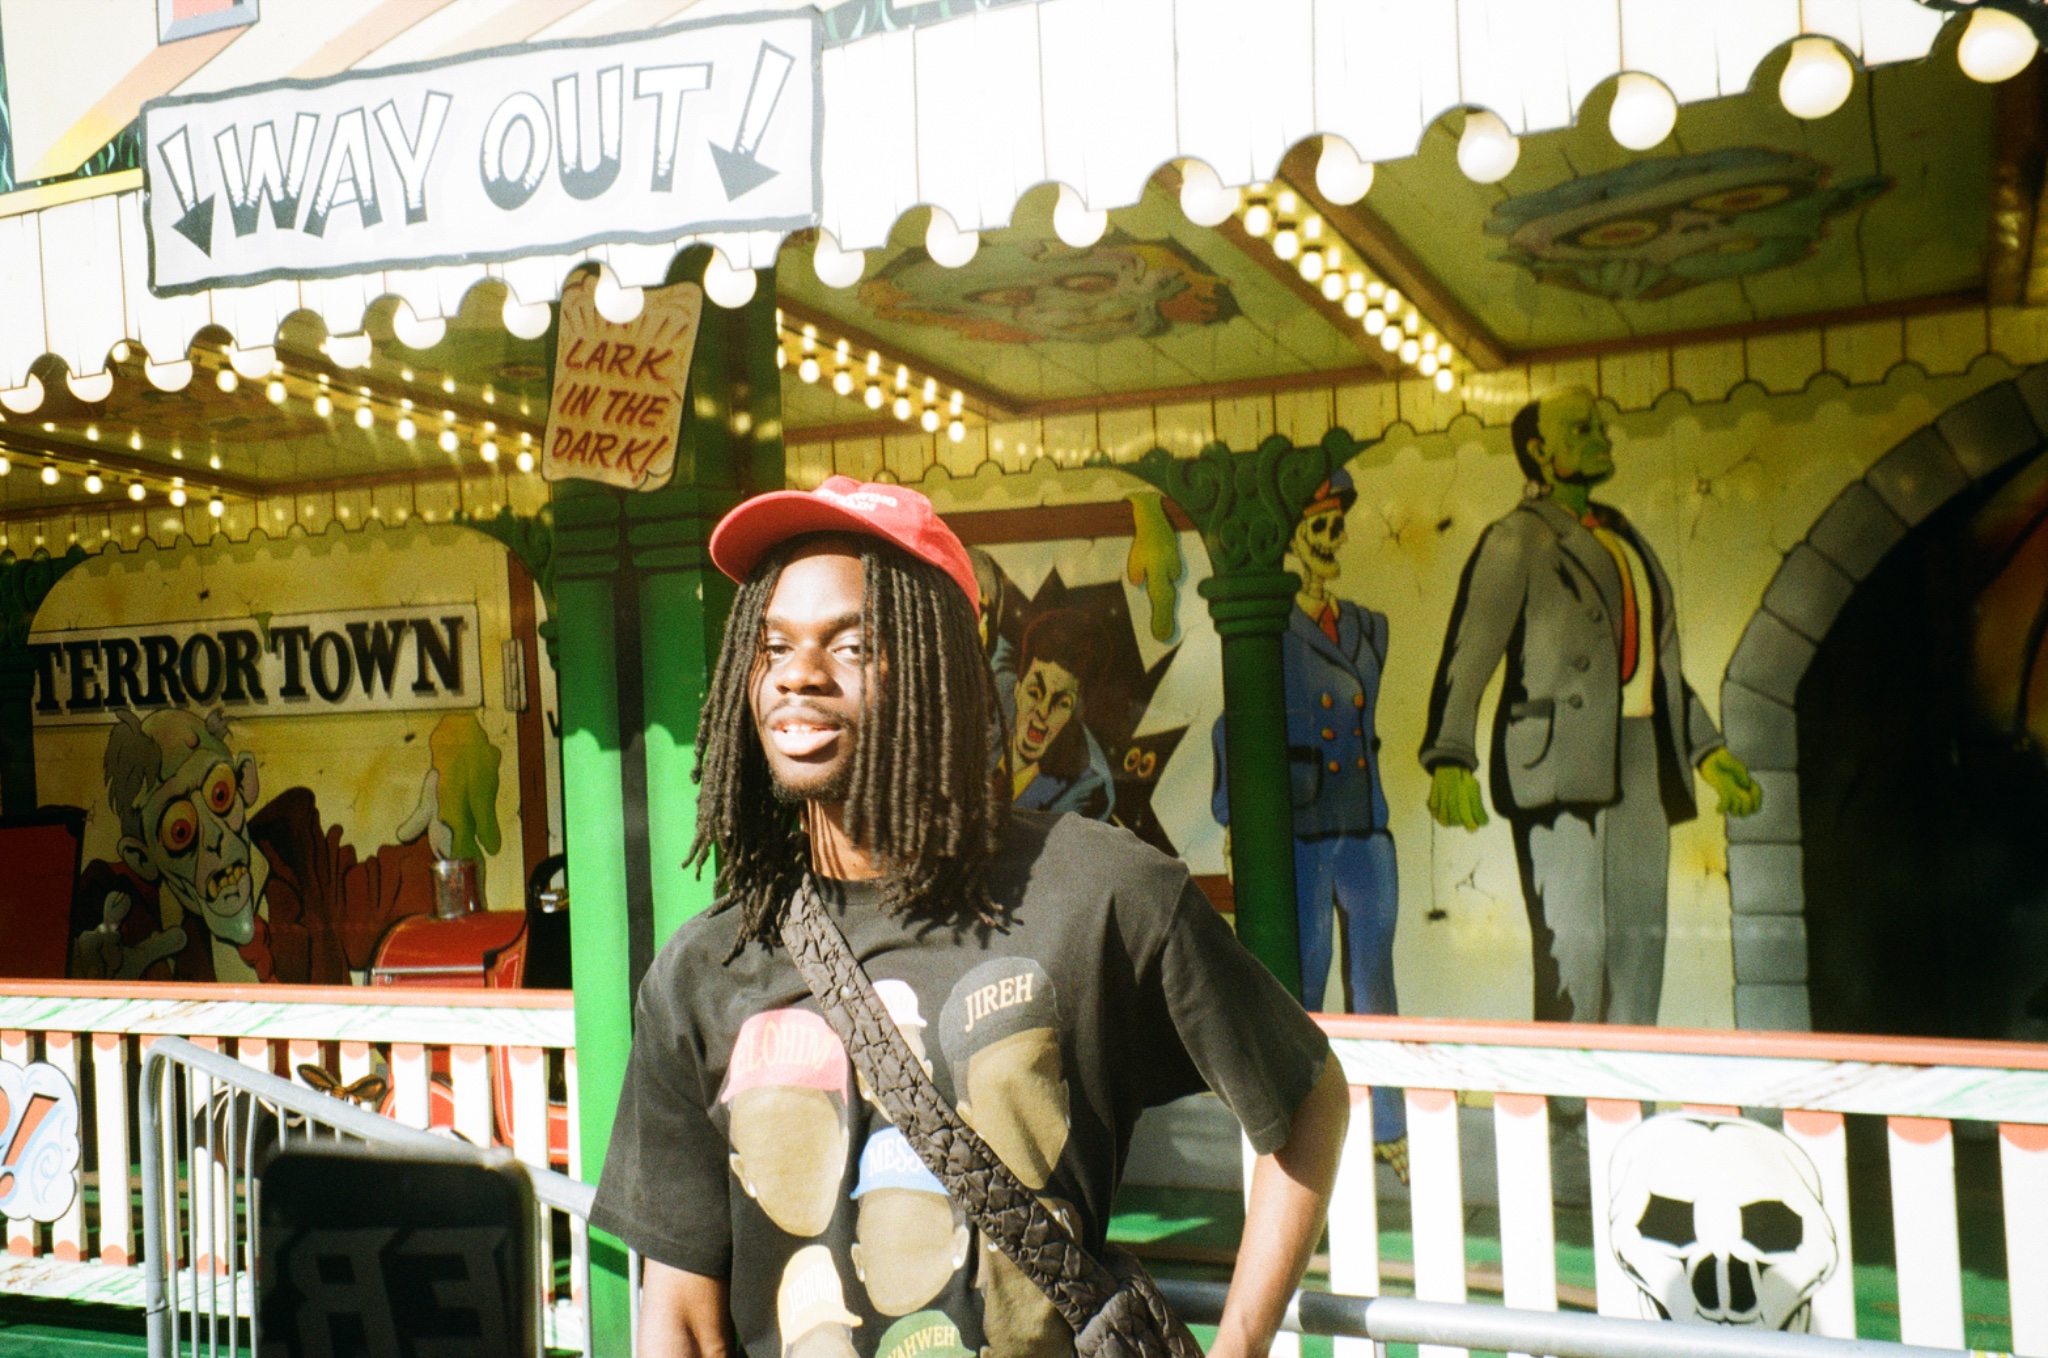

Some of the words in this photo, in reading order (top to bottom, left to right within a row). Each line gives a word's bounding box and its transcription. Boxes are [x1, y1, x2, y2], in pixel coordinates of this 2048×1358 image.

[213, 90, 454, 239] WAY
[479, 61, 713, 211] OUT
[564, 336, 673, 382] LARK
[559, 382, 600, 417] IN
[602, 389, 670, 428] THE
[551, 426, 669, 484] DARK!
[965, 972, 1035, 1031] JIREH
